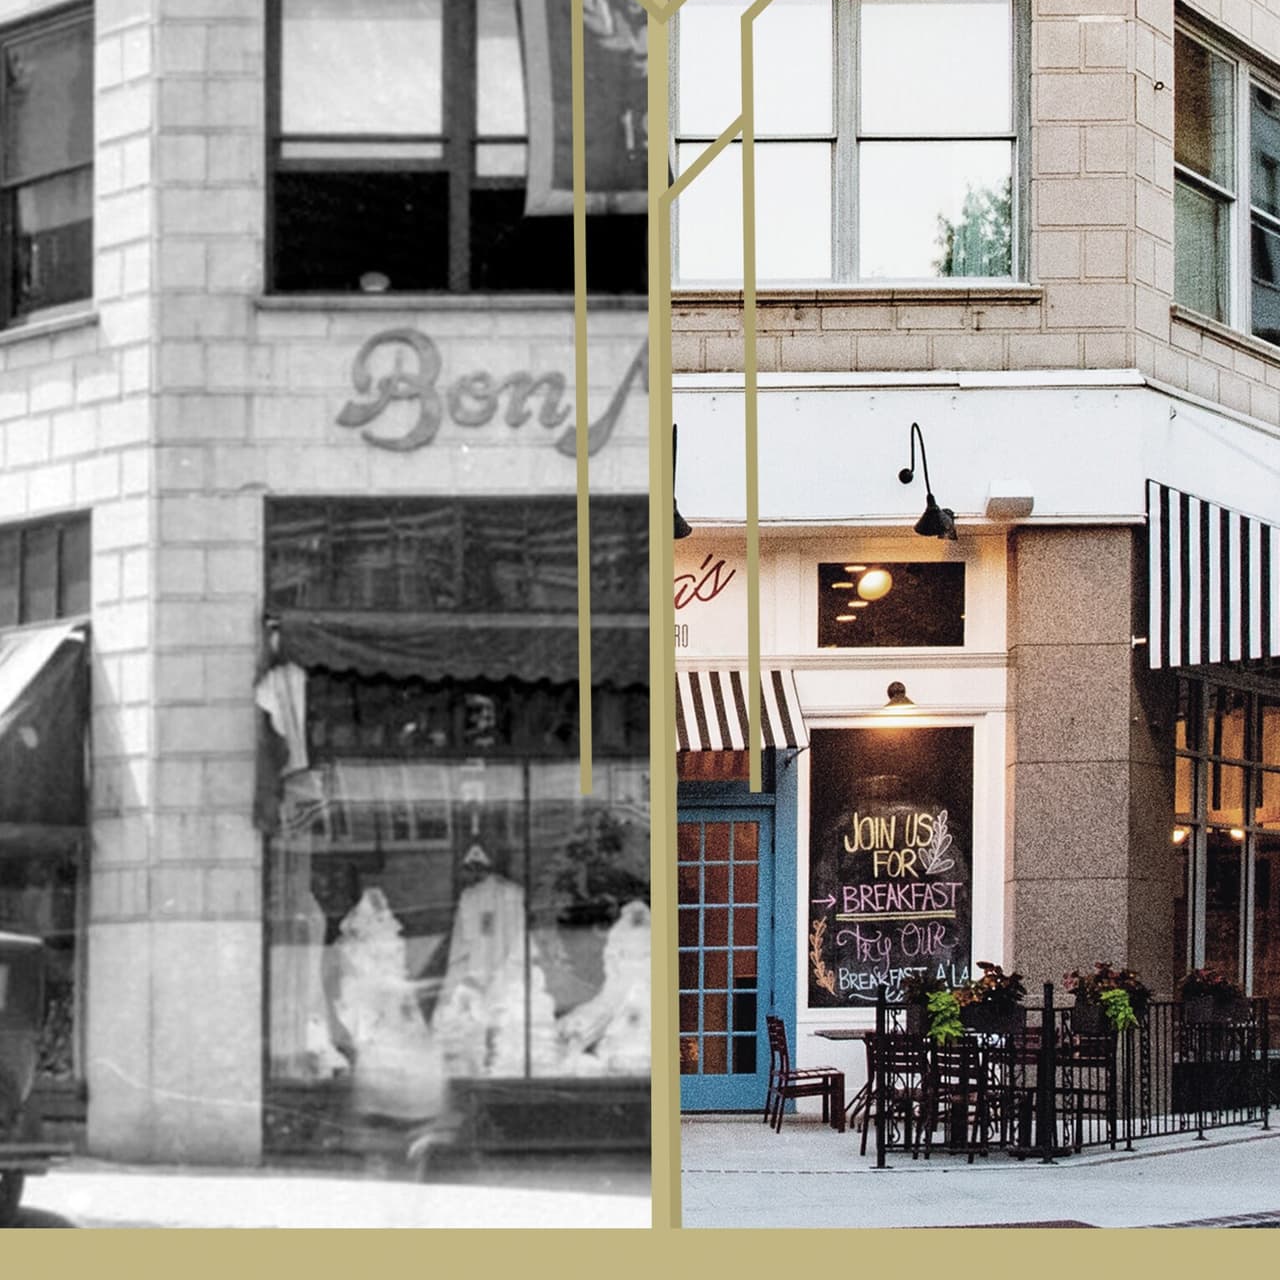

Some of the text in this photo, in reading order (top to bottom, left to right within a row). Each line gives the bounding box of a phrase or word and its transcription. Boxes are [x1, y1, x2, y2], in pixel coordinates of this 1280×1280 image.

[335, 327, 571, 452] Bon
[844, 812, 934, 852] JOIN US
[873, 849, 919, 878] FOR
[842, 882, 963, 913] BREAKFAST
[898, 921, 958, 957] OUR
